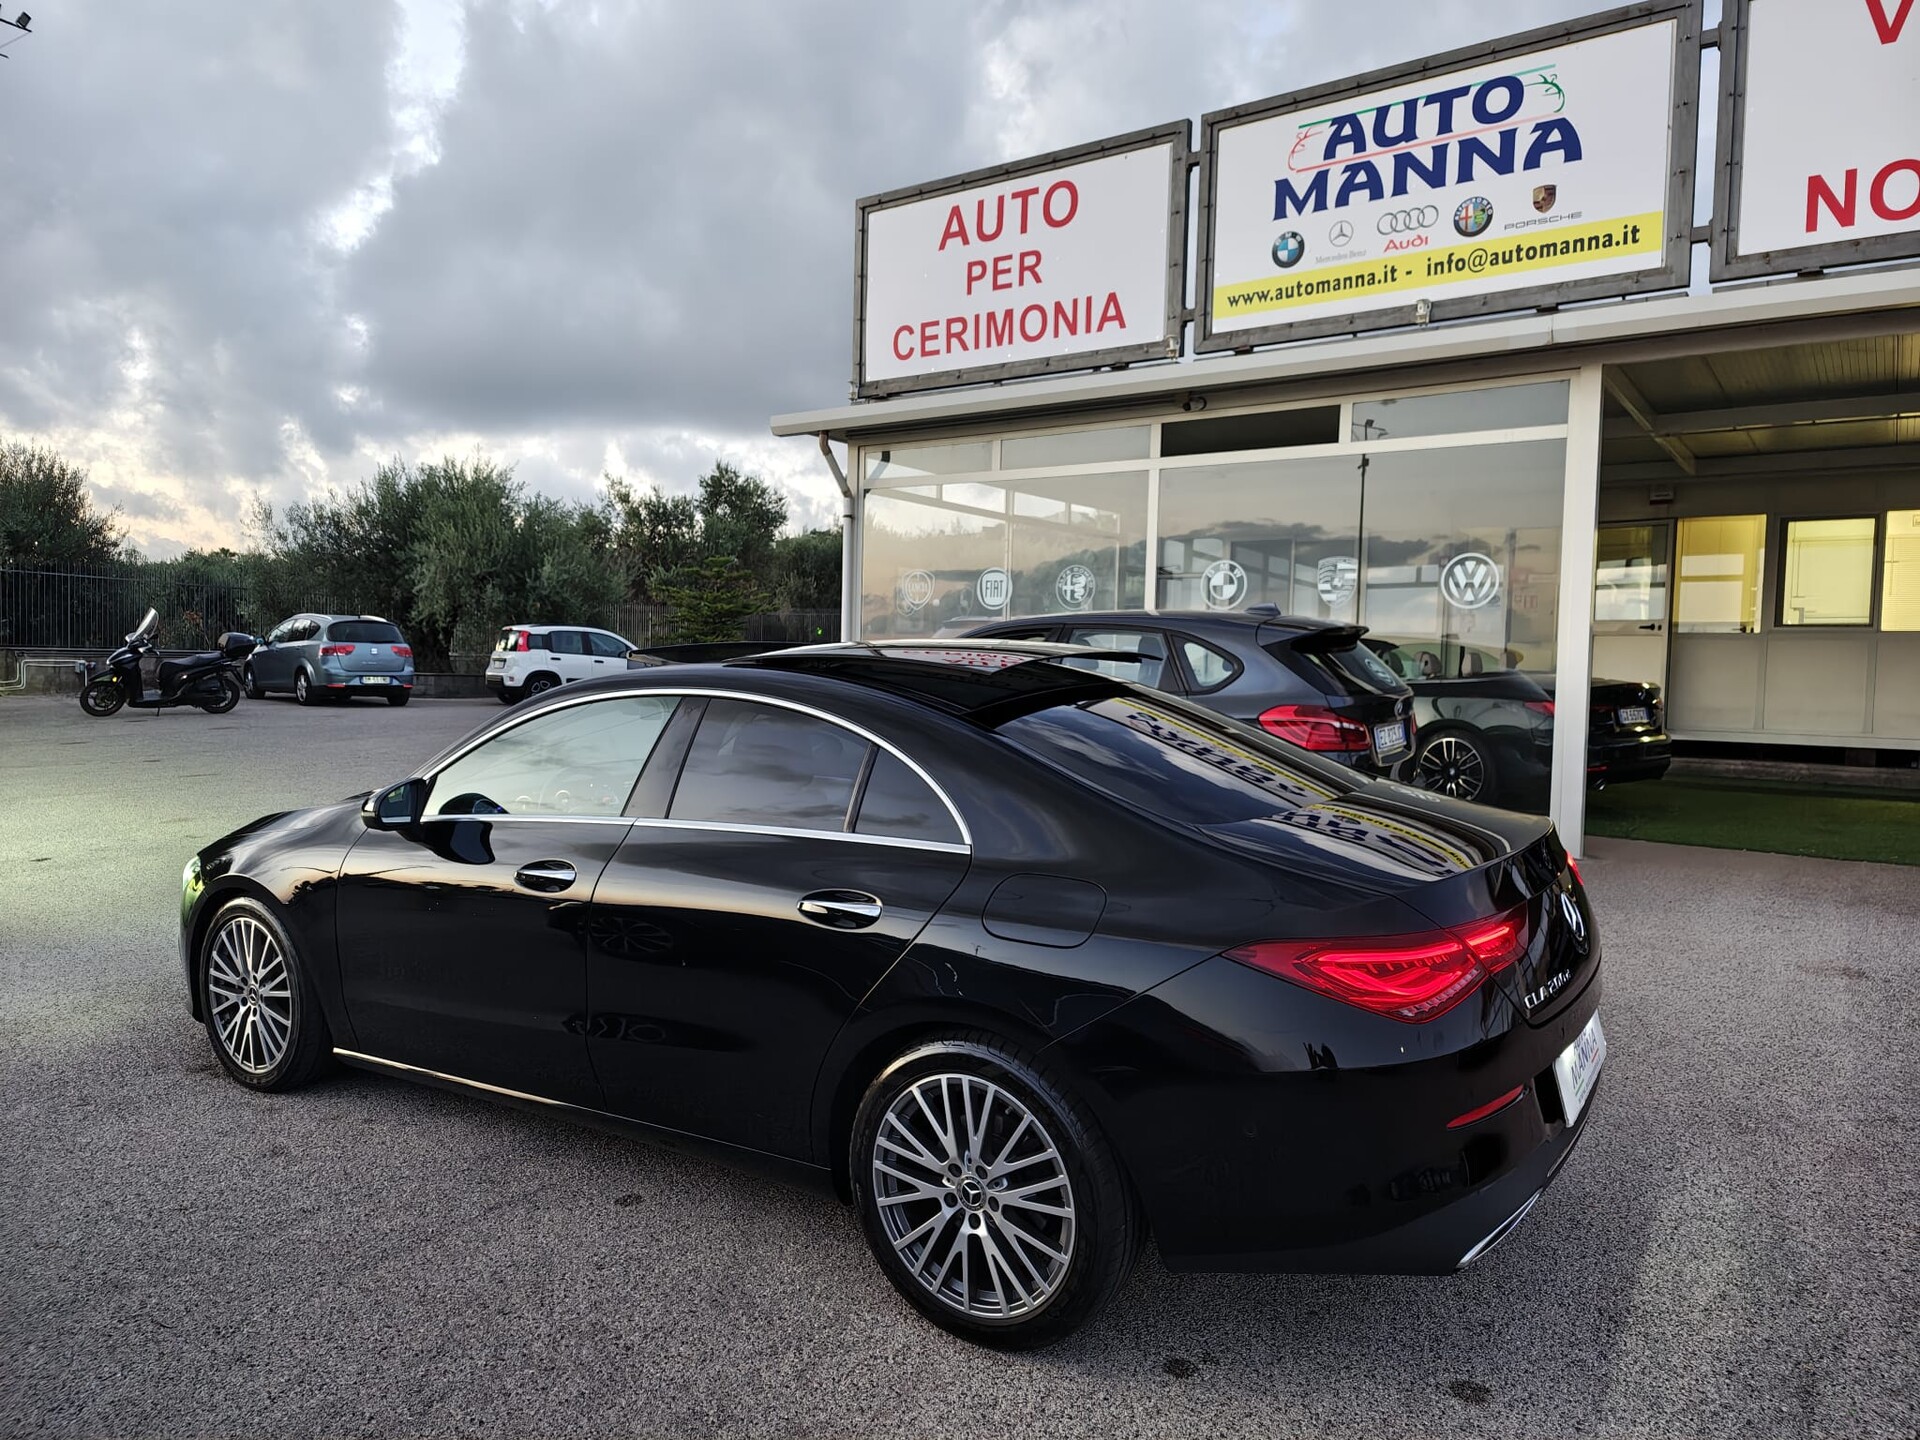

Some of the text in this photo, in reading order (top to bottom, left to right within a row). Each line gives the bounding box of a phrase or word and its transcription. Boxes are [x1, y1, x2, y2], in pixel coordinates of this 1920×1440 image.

[1322, 74, 1525, 161] AUTO
[1272, 116, 1583, 222] MANNA
[938, 179, 1079, 251] AUTO
[1383, 234, 1430, 253] Audi
[1503, 211, 1583, 231] PORSCHE
[966, 249, 1043, 296] PER
[1227, 263, 1398, 308] www.automanna.it
[1426, 223, 1641, 278] info@automanna.it
[892, 291, 1127, 361] CERIMONIA
[984, 580, 1005, 598] FIAT
[1206, 562, 1243, 579] BMW
